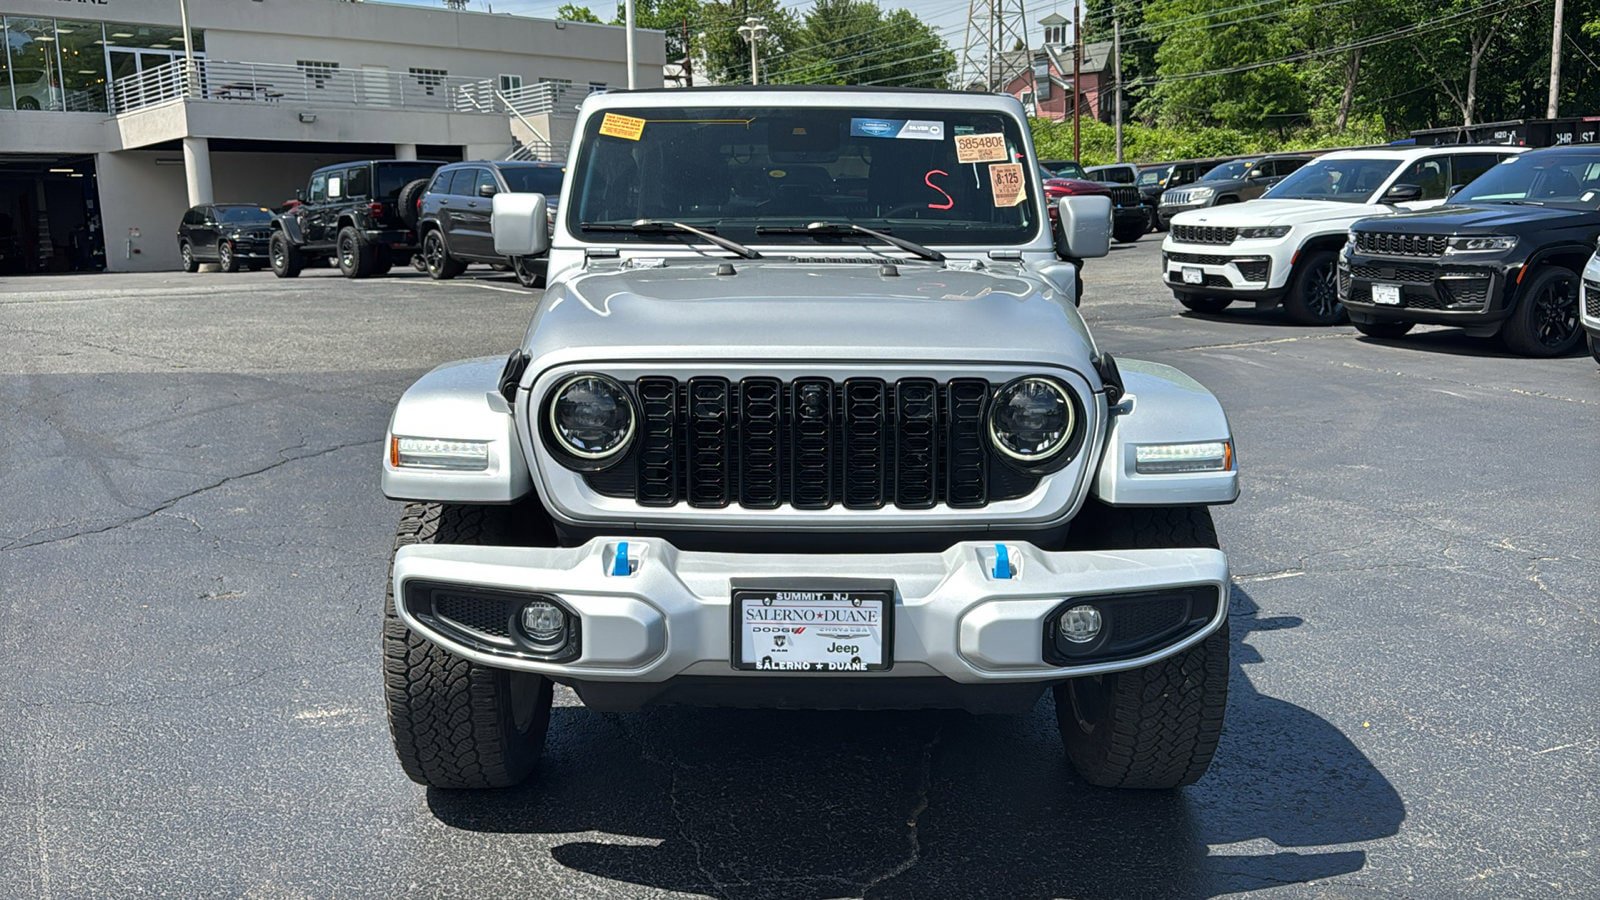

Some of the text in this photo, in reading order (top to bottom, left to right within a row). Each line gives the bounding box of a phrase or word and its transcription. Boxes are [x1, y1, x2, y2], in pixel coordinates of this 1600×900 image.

[925, 169, 954, 210] S
[832, 592, 849, 601] NJ
[746, 608, 878, 623] SALERNO DUANE
[827, 642, 860, 655] Jeep
[755, 661, 868, 671] SALERNO DUANE
